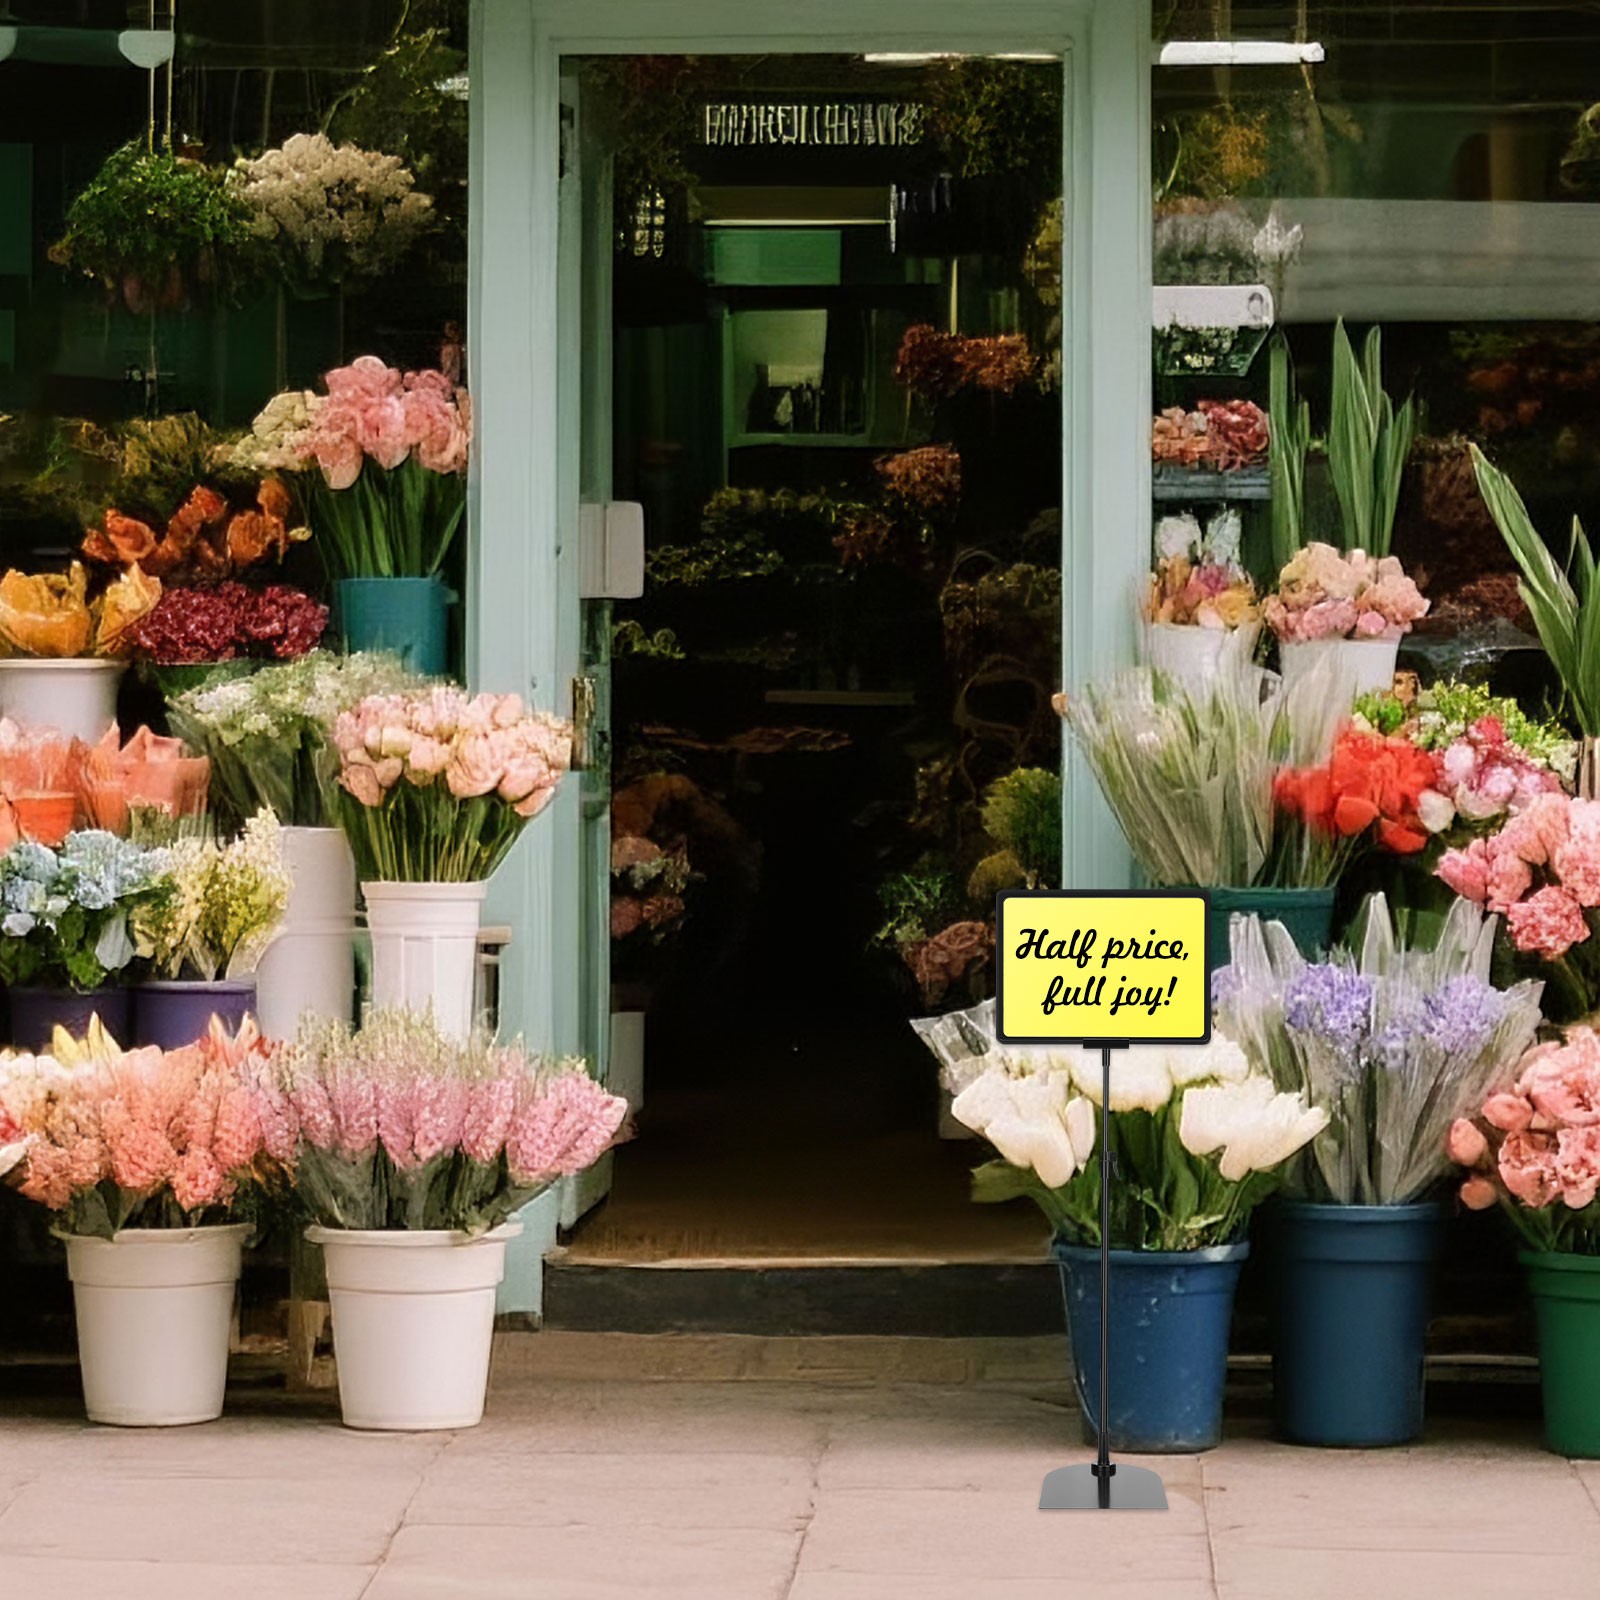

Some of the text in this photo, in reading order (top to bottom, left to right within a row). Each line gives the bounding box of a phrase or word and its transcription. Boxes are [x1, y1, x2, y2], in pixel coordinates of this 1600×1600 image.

[1015, 928, 1189, 969] Half price,
[1040, 975, 1178, 1016] full joy!
